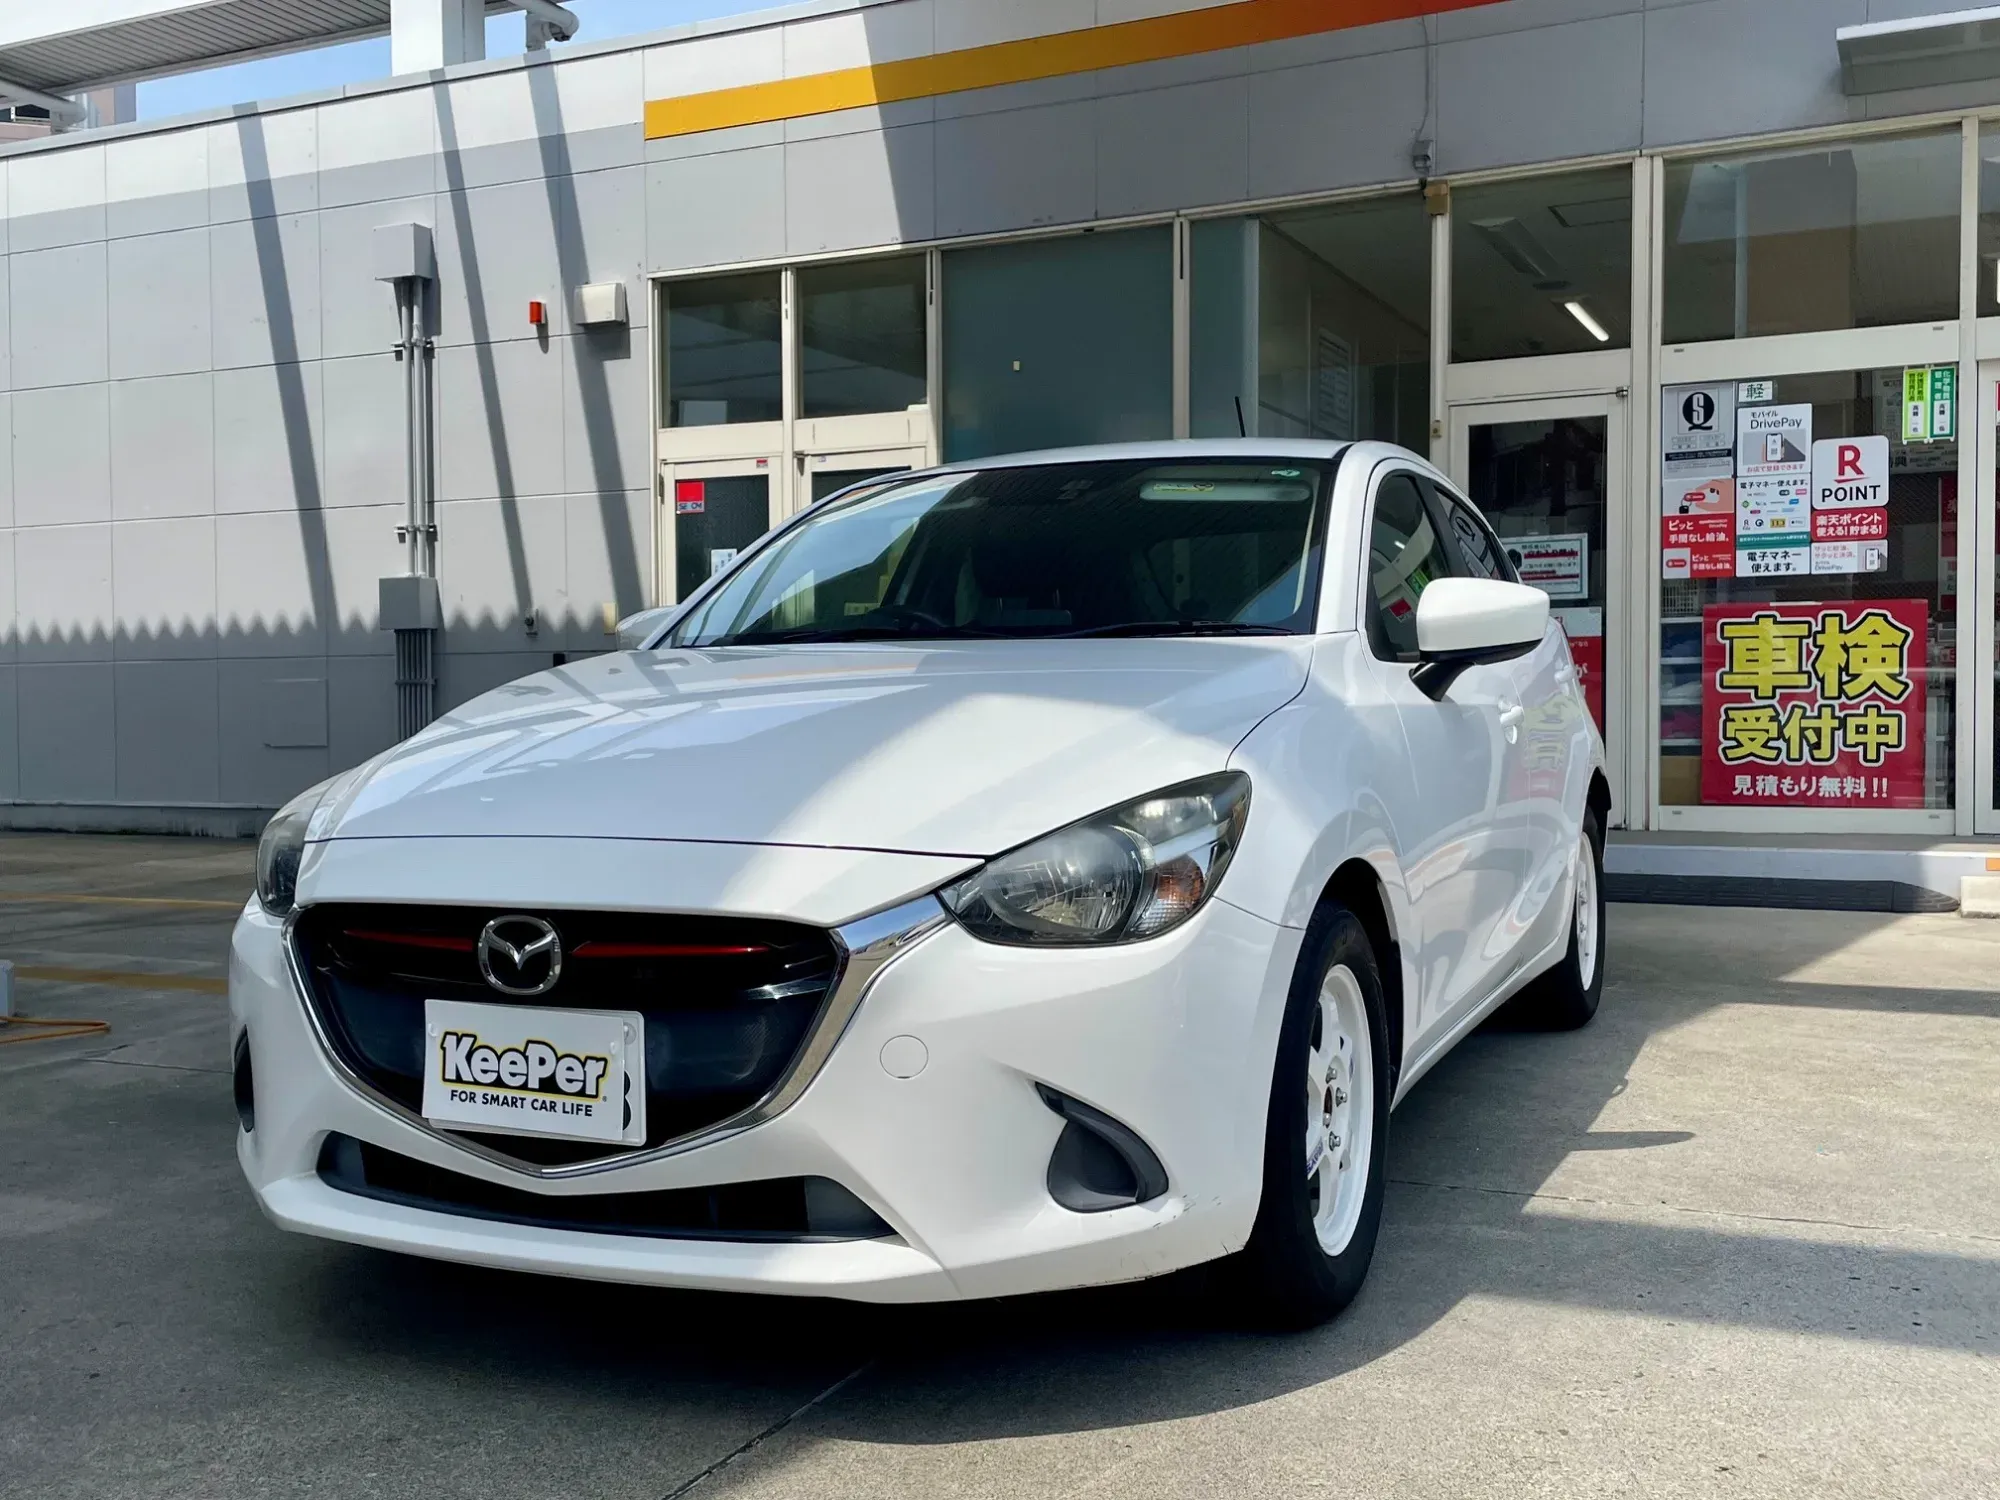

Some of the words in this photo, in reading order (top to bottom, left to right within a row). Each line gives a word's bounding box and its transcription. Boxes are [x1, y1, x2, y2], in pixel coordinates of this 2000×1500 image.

[1746, 383, 1765, 400] 軽
[1751, 410, 1779, 419] モバイル
[1750, 418, 1802, 430] DrivePay
[1838, 444, 1865, 477] R
[1821, 485, 1881, 503] POINT
[1668, 519, 1694, 531] ピッと
[1816, 512, 1882, 527] 楽天ポイント
[1747, 551, 1802, 562] 電子マネー
[1751, 562, 1797, 573] 使えます。
[1719, 610, 1911, 701] 車検
[1719, 702, 1904, 764] 受付中
[440, 1031, 608, 1100] KeePer
[450, 1090, 476, 1104] FOR
[481, 1093, 525, 1109] SMART
[531, 1098, 557, 1113] CAR
[562, 1103, 593, 1117] LIFE
